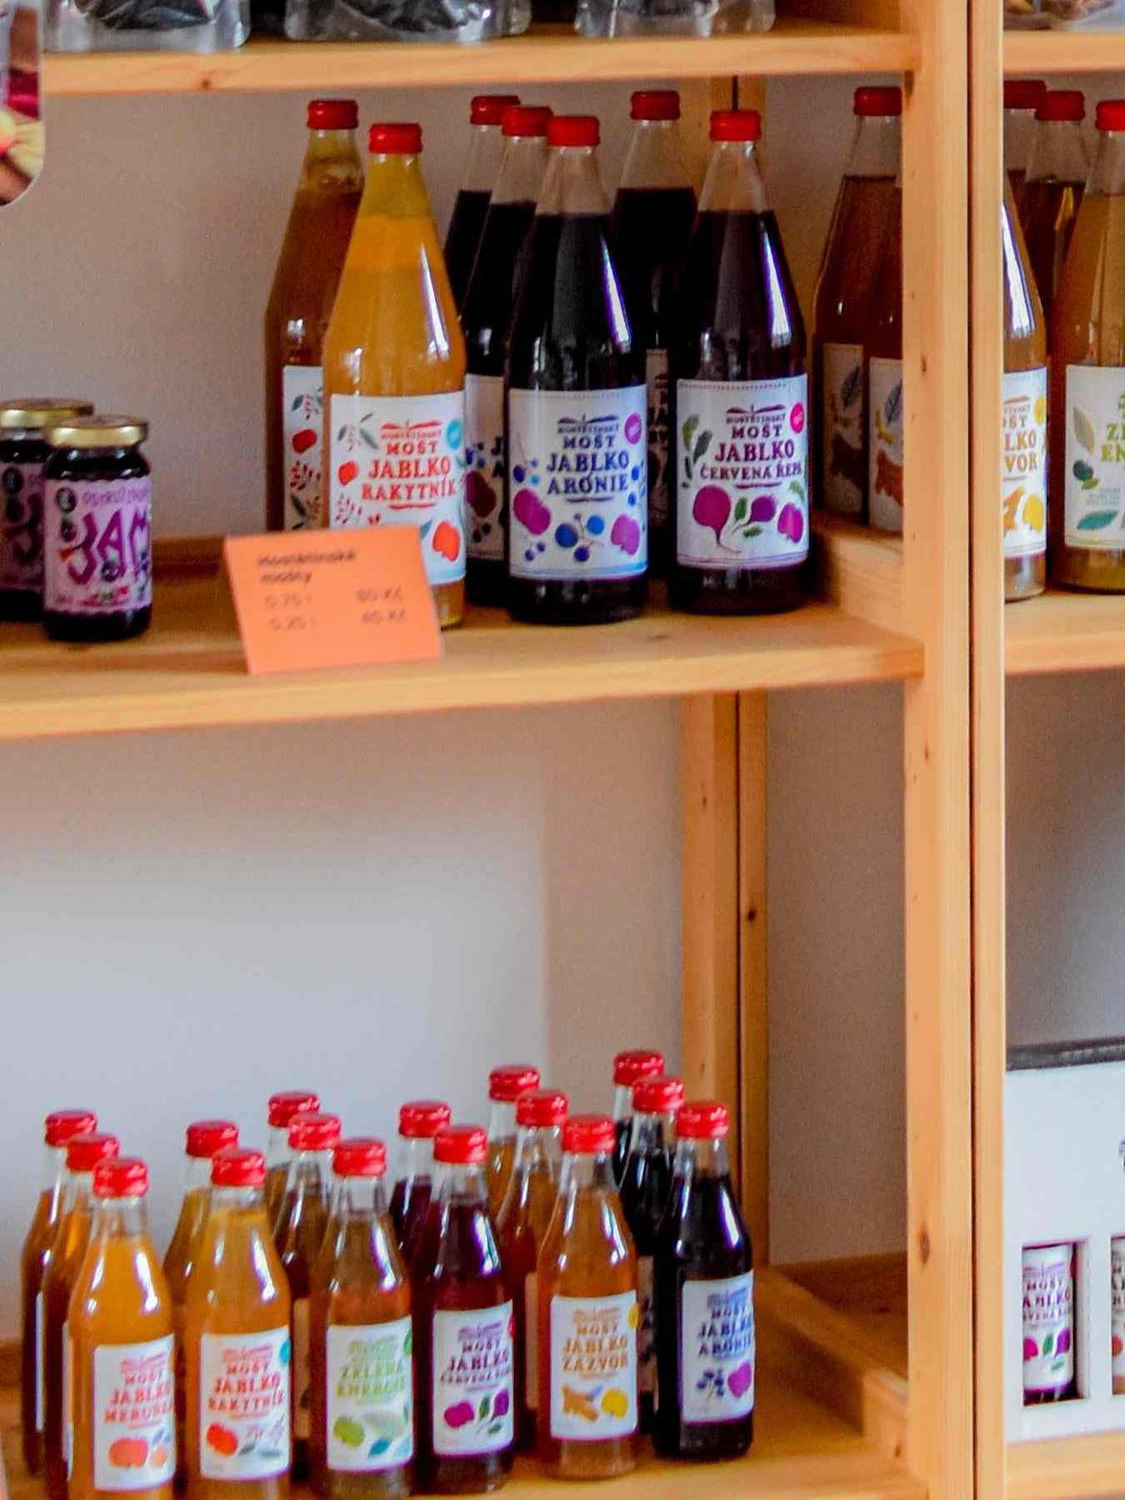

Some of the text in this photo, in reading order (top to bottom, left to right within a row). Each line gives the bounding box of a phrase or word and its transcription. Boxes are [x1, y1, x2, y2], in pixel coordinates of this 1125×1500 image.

[563, 434, 615, 449] MOŠT
[732, 424, 782, 439] MOŠT
[386, 439, 438, 455] MOŠT
[715, 440, 795, 461] JABLKO
[369, 456, 450, 478] JABLKO
[547, 452, 630, 472] JABLKO
[700, 464, 772, 480] ČERVENÁ
[362, 478, 456, 500] RAKYTNÍK
[547, 471, 628, 494] ARONIE
